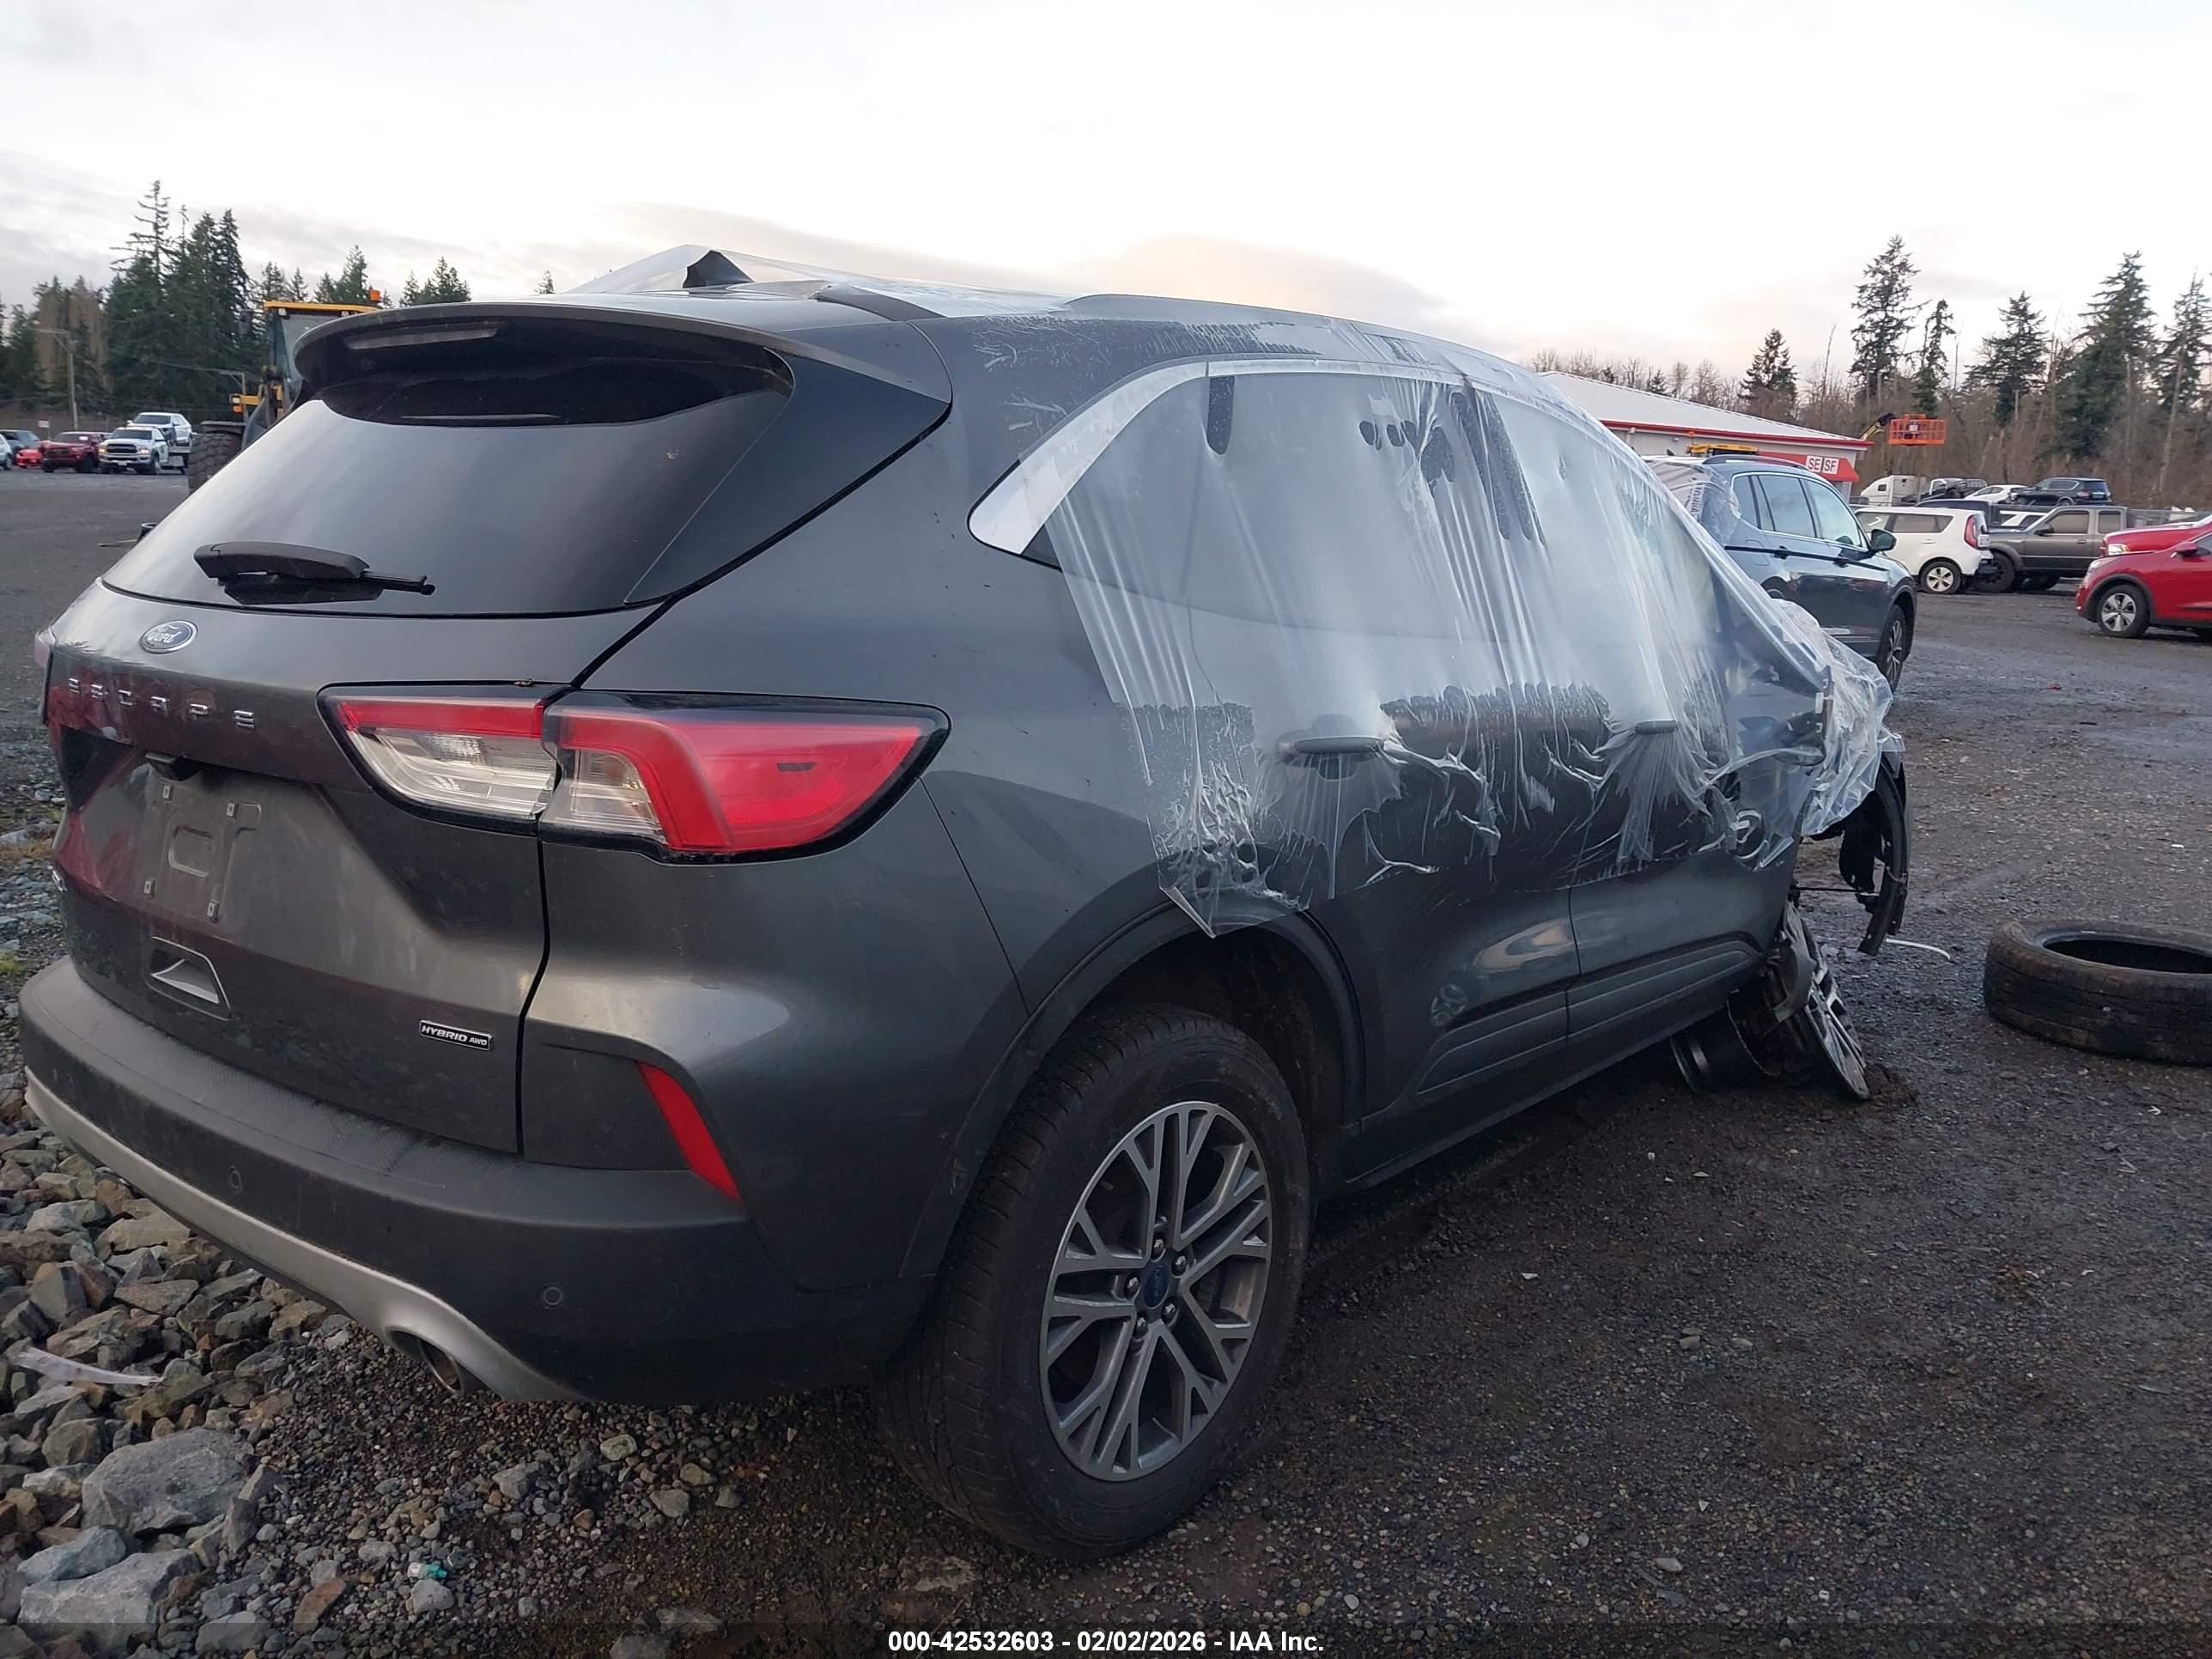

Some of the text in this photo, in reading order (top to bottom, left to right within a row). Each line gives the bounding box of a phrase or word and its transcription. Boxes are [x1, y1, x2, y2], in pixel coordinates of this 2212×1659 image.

[1808, 458, 1837, 471] SE SF
[147, 625, 182, 644] Ford
[68, 678, 255, 729] ESCAPE
[421, 1024, 488, 1046] HYBRID AWD
